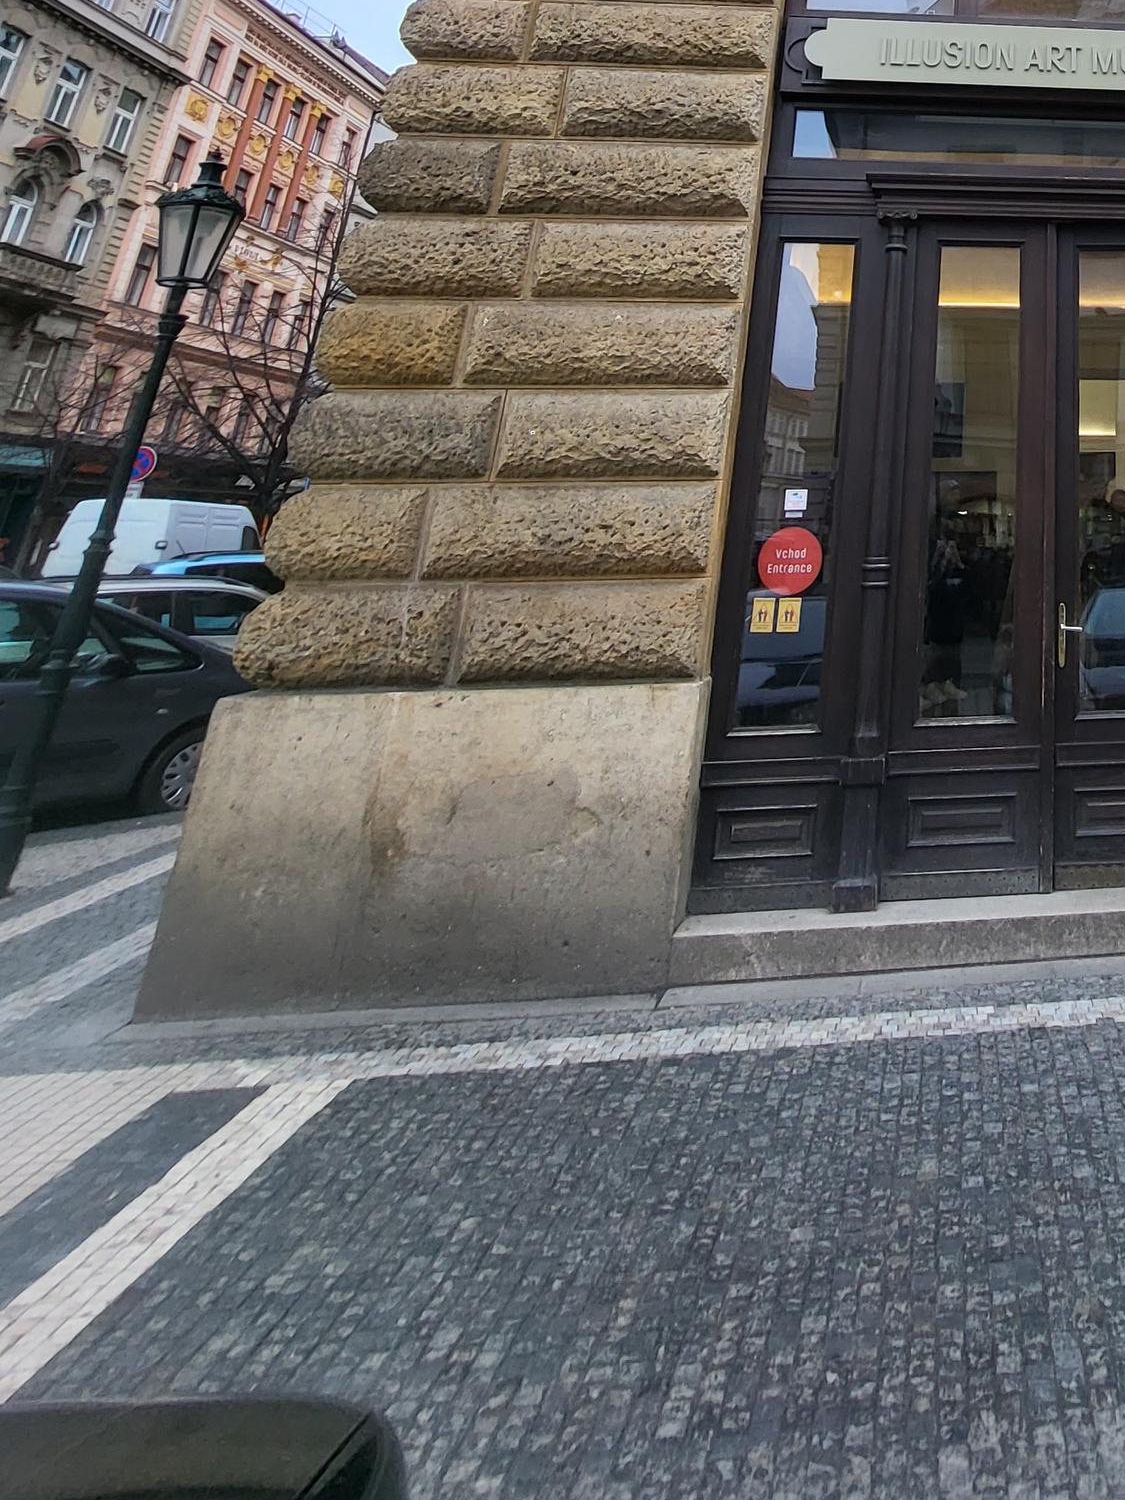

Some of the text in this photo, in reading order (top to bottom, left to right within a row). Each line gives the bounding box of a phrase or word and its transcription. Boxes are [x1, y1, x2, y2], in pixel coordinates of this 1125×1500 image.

[880, 38, 1015, 71] ILLUSION
[1023, 45, 1082, 73] ART
[776, 547, 807, 559] Vchod
[767, 563, 812, 574] Entrance
